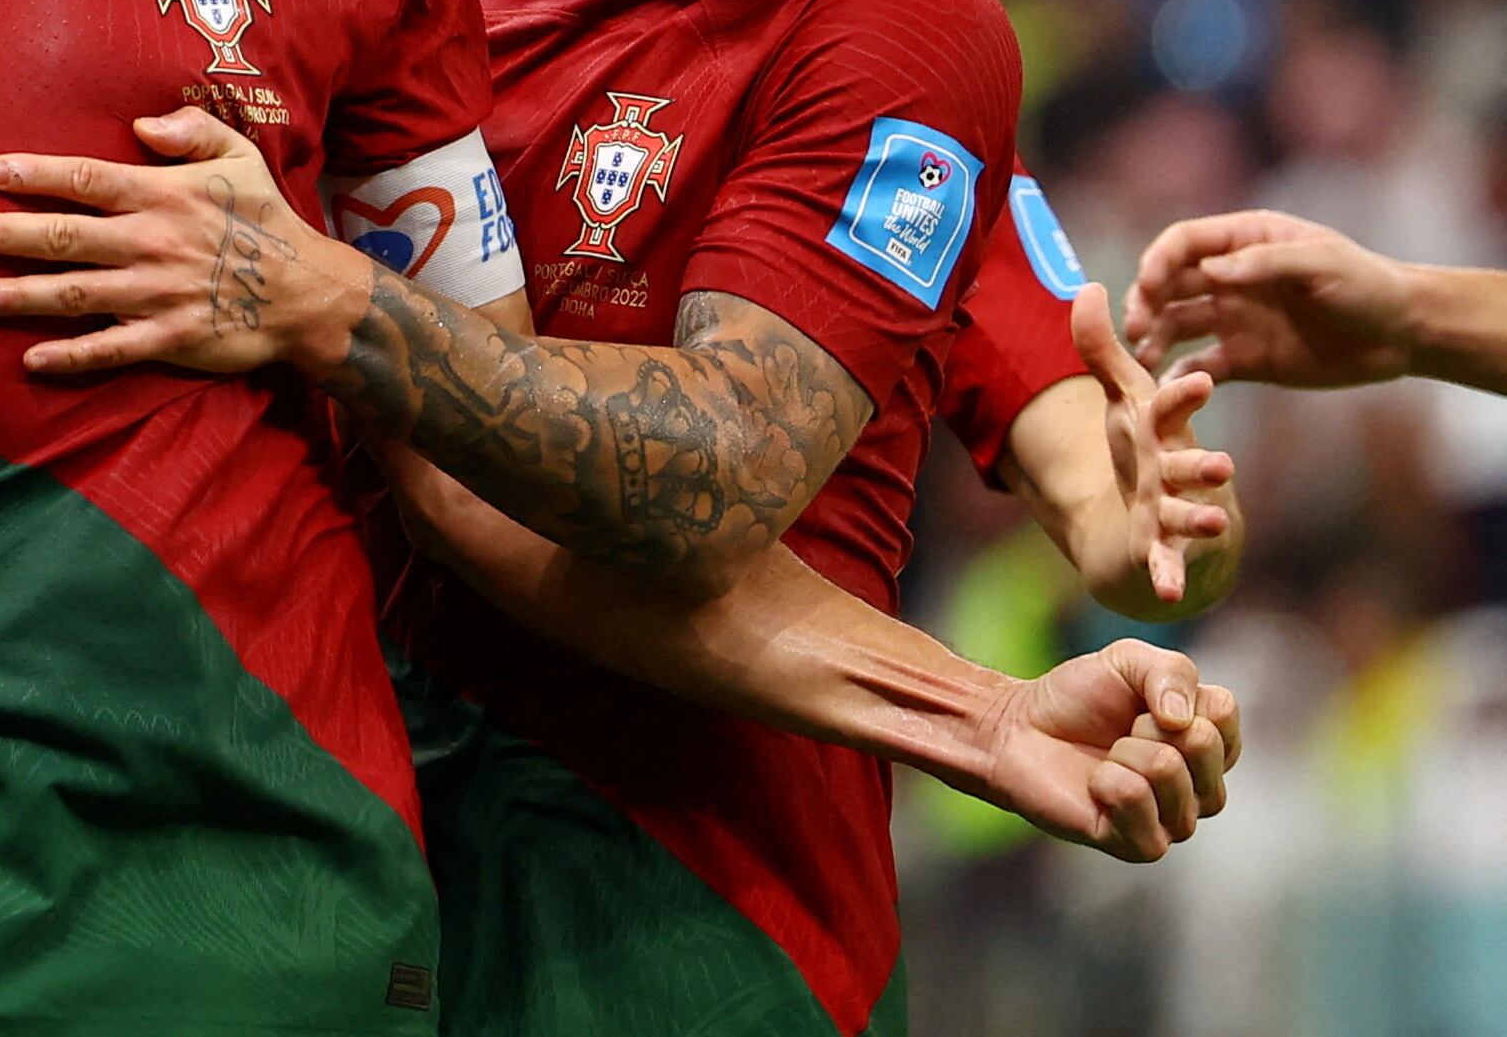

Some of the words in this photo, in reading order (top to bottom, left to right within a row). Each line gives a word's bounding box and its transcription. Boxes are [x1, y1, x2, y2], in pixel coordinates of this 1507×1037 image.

[895, 187, 946, 220] FOOTBALL
[891, 201, 939, 236] UNITES
[884, 215, 902, 233] the
[899, 224, 931, 254] World
[890, 242, 907, 259] FIFA
[559, 297, 595, 320] DOHA
[610, 287, 648, 308] 2022
